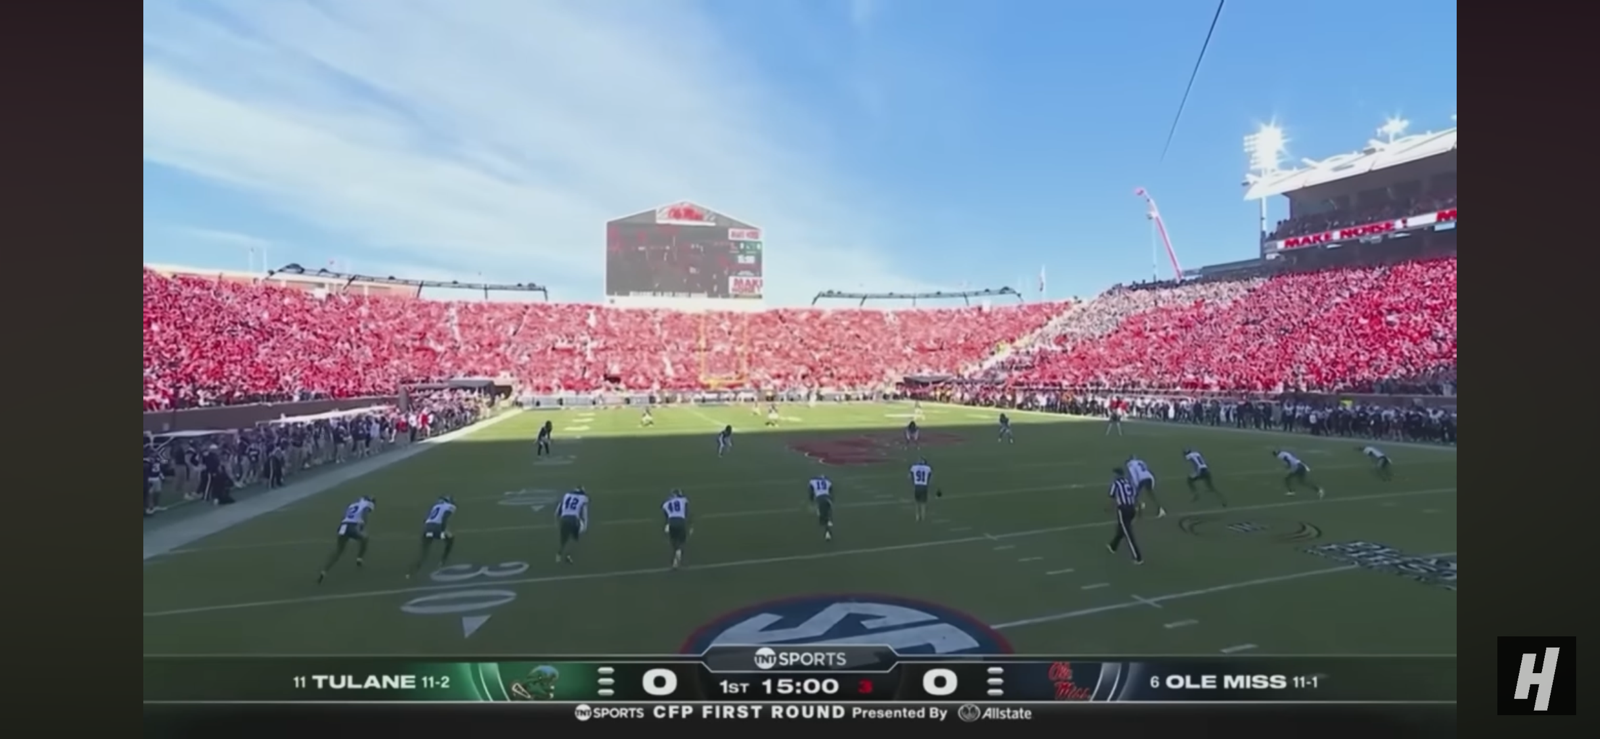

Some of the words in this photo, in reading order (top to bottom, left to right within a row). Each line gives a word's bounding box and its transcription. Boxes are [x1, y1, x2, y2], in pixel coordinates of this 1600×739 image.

[1284, 232, 1332, 248] MAKE
[1339, 219, 1396, 239] NOISE
[916, 470, 926, 483] 91
[399, 560, 530, 615] 30
